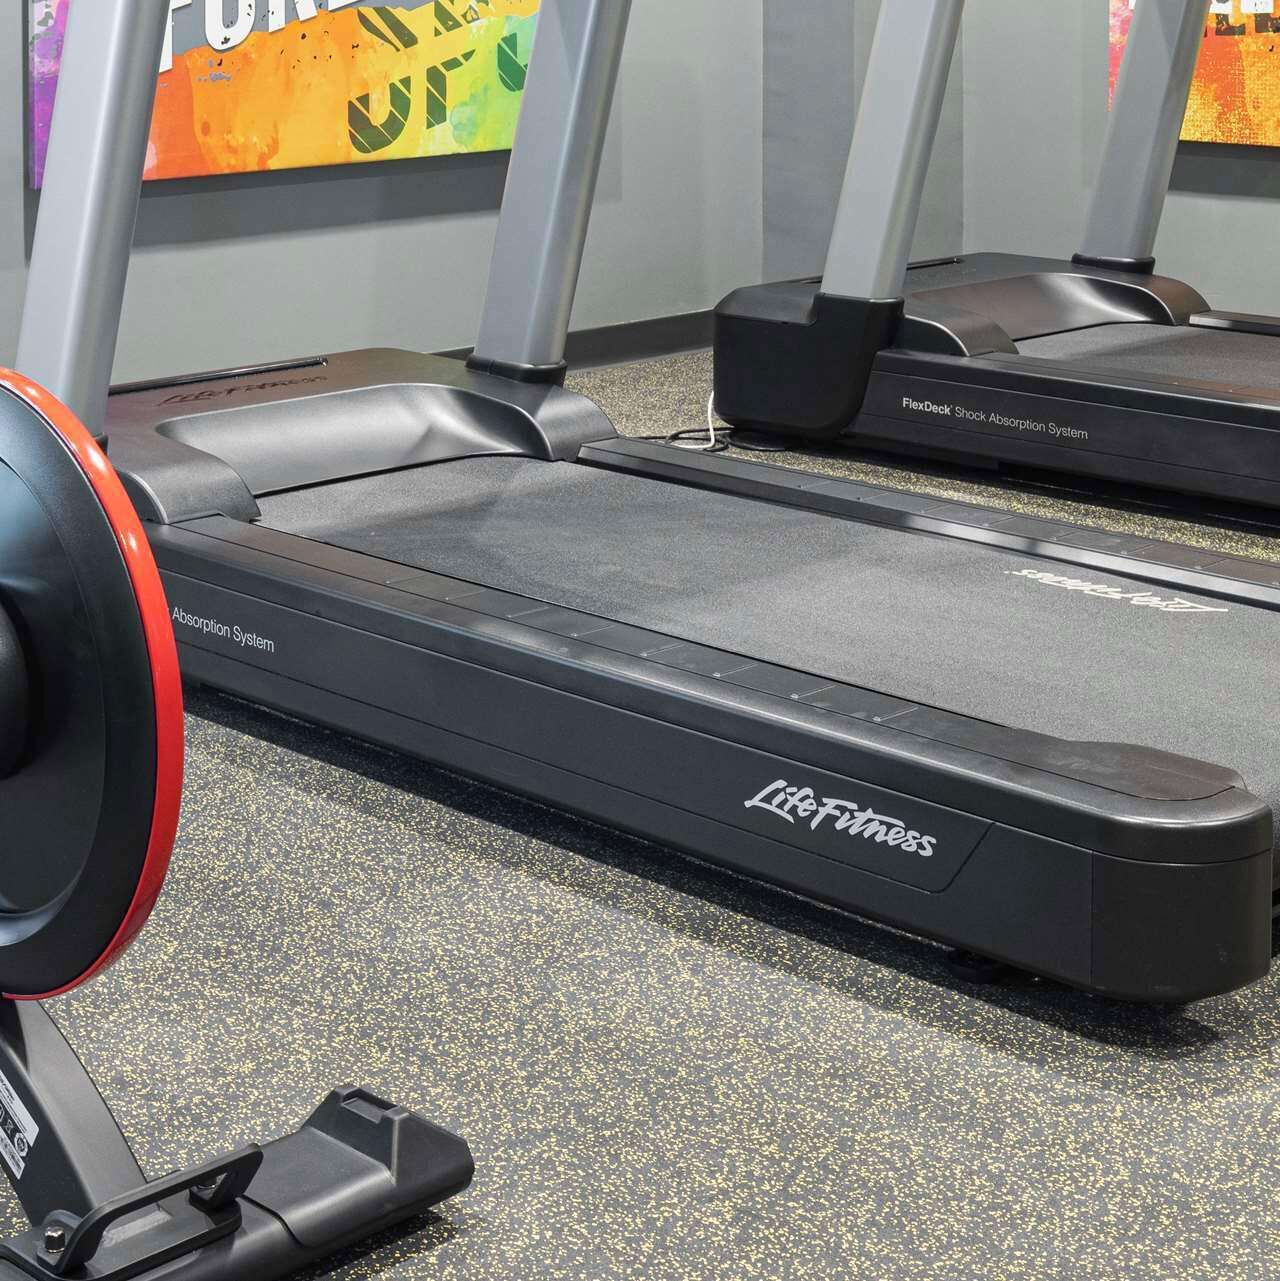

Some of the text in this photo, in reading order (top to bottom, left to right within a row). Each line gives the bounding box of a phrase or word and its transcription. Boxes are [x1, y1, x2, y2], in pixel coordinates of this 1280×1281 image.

[955, 406, 986, 422] Shock
[989, 413, 1046, 432] Absorption
[1048, 422, 1089, 440] System
[172, 607, 275, 653] Absorption System
